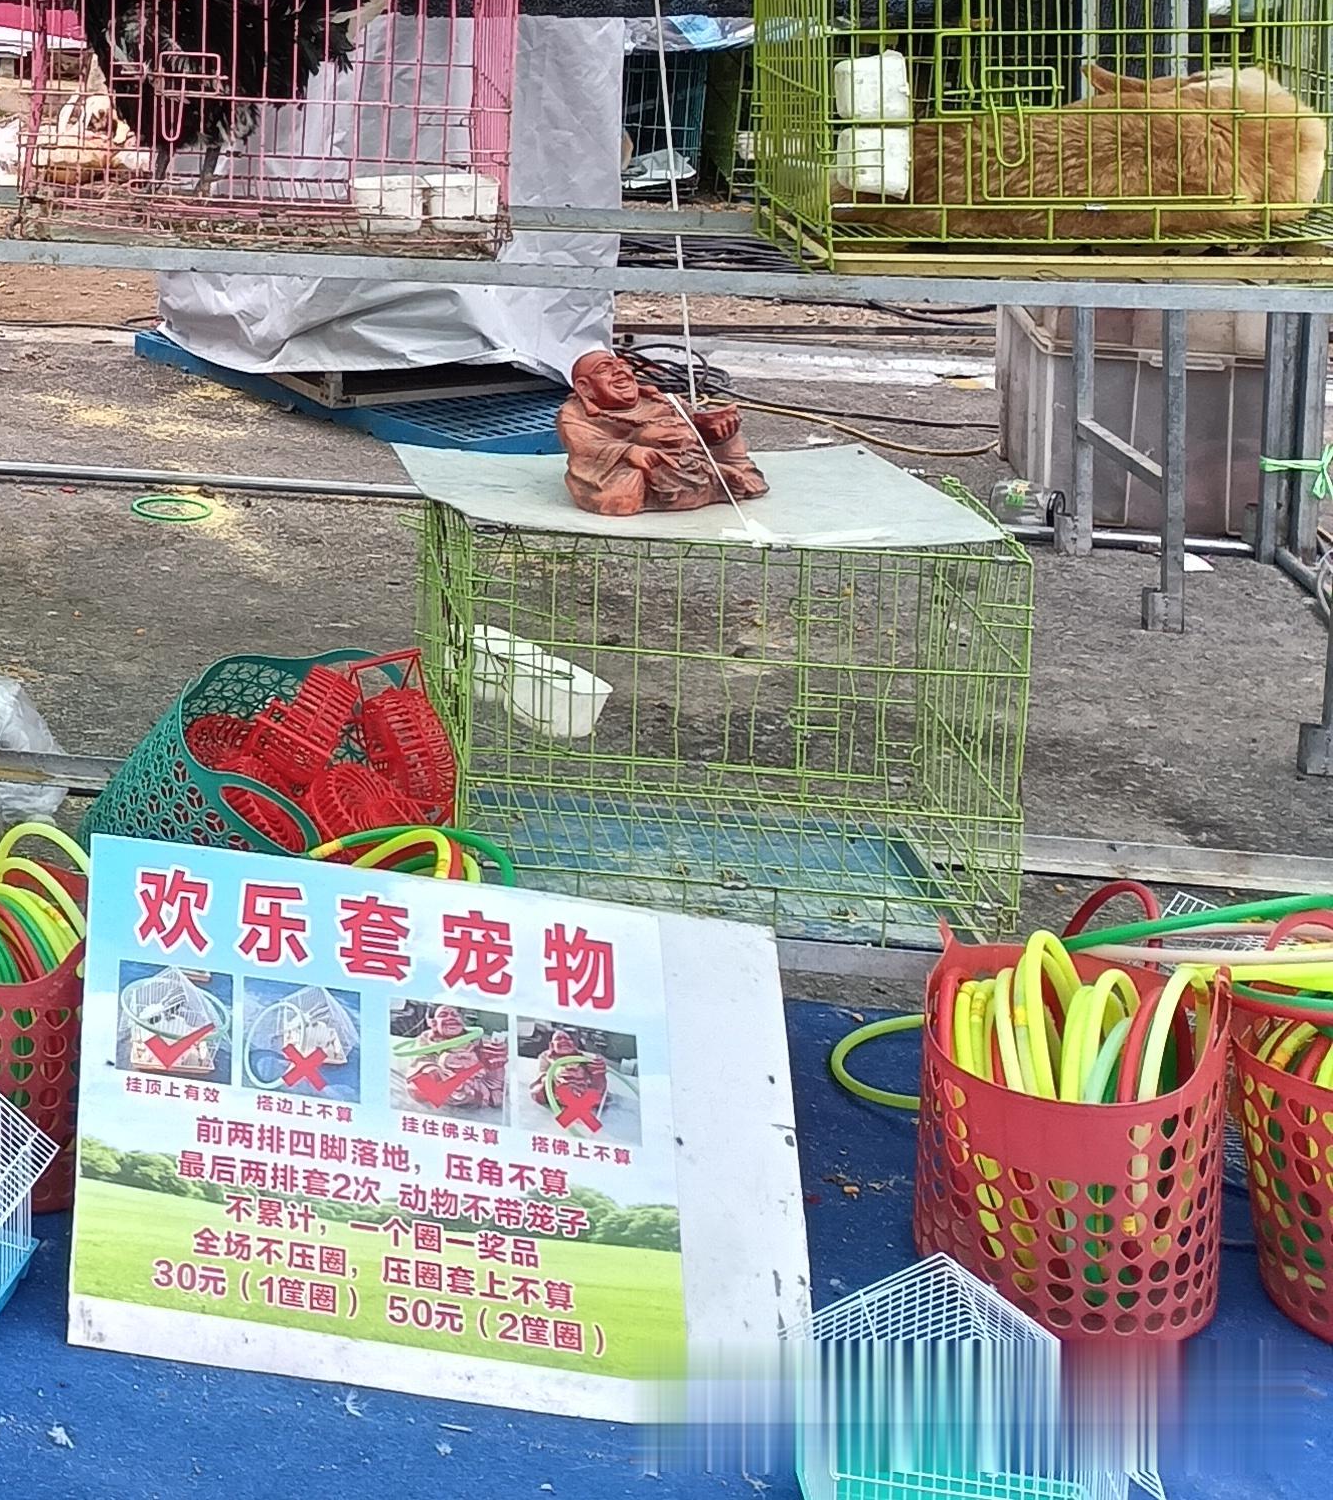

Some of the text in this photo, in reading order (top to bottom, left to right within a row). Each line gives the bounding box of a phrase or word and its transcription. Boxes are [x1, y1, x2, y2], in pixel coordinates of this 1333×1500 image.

[138, 869, 615, 1010] 欢乐套宠物
[125, 1076, 221, 1104] 挂顶上有效
[256, 1094, 353, 1123] 搭边上不算
[401, 1115, 500, 1146] 挂住佛头算
[531, 1135, 632, 1166] 搭佛上不算
